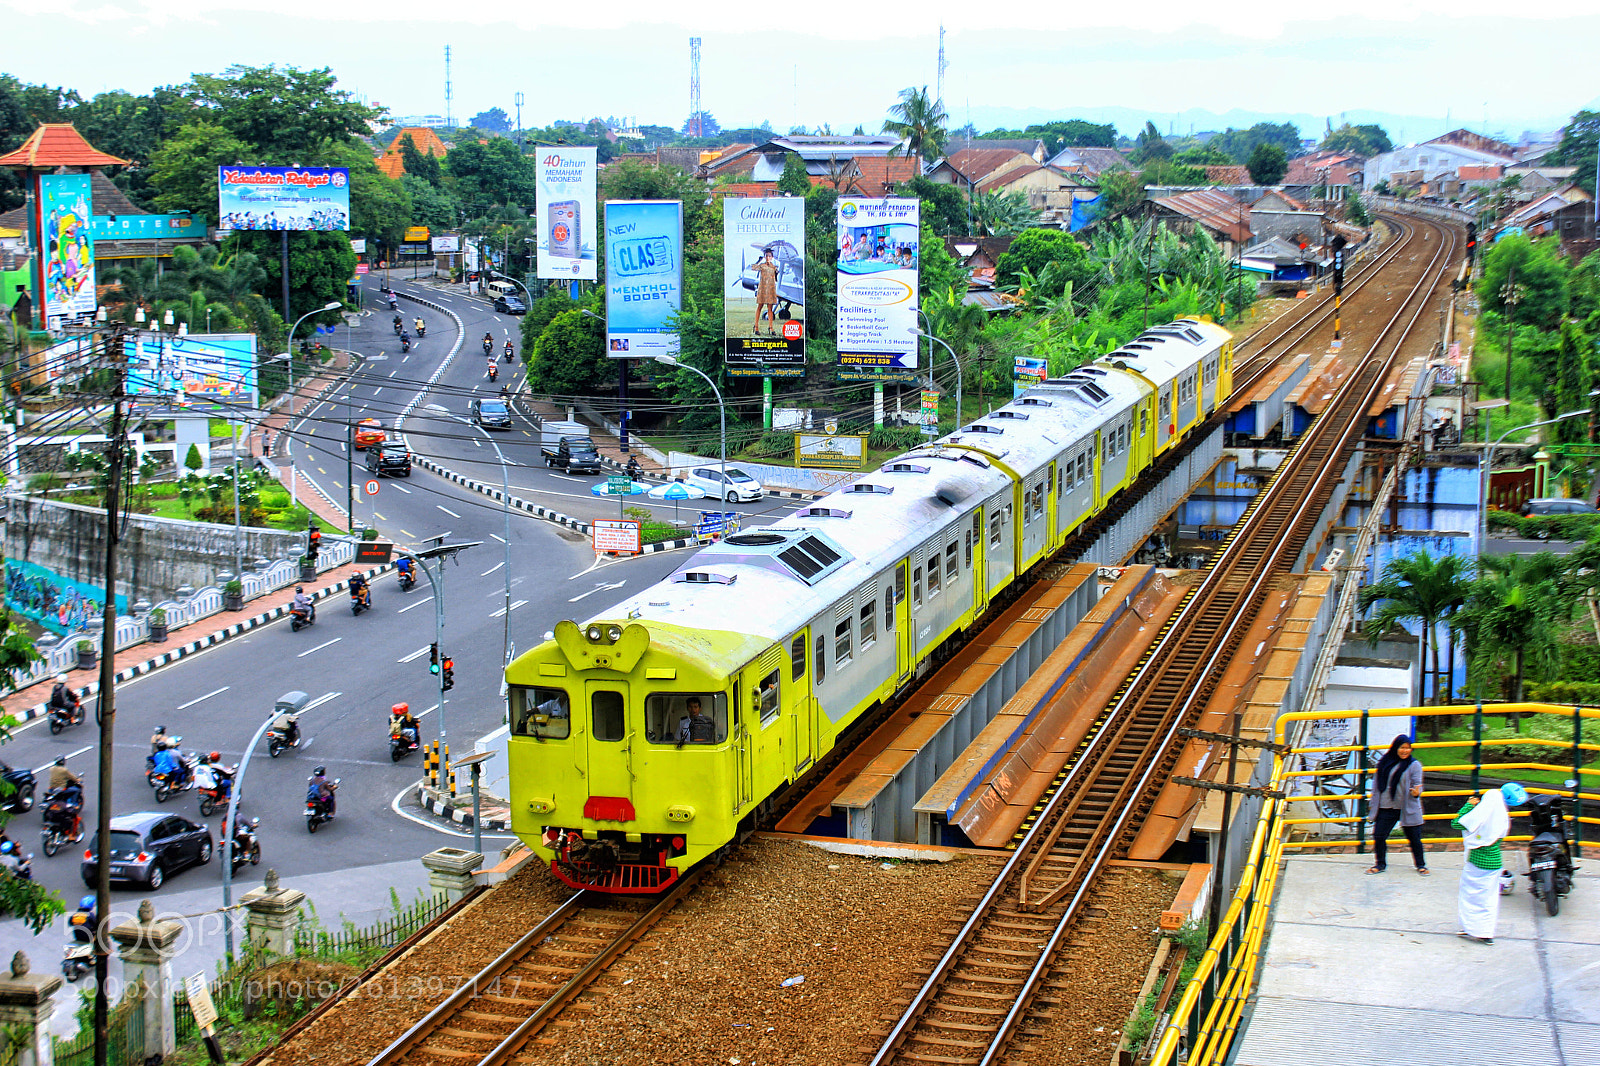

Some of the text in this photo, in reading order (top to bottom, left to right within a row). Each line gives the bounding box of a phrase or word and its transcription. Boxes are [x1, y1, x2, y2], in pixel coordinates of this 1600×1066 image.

[543, 154, 586, 168] 40 Tahun
[285, 171, 330, 188] Rakyat
[741, 205, 786, 220] Cultural
[608, 223, 636, 236] NEW
[737, 224, 791, 233] HERITAGE
[619, 243, 655, 272] CLAS
[612, 283, 677, 295] MENTHOL
[623, 292, 669, 302] BOOST
[840, 306, 872, 314] Facilities
